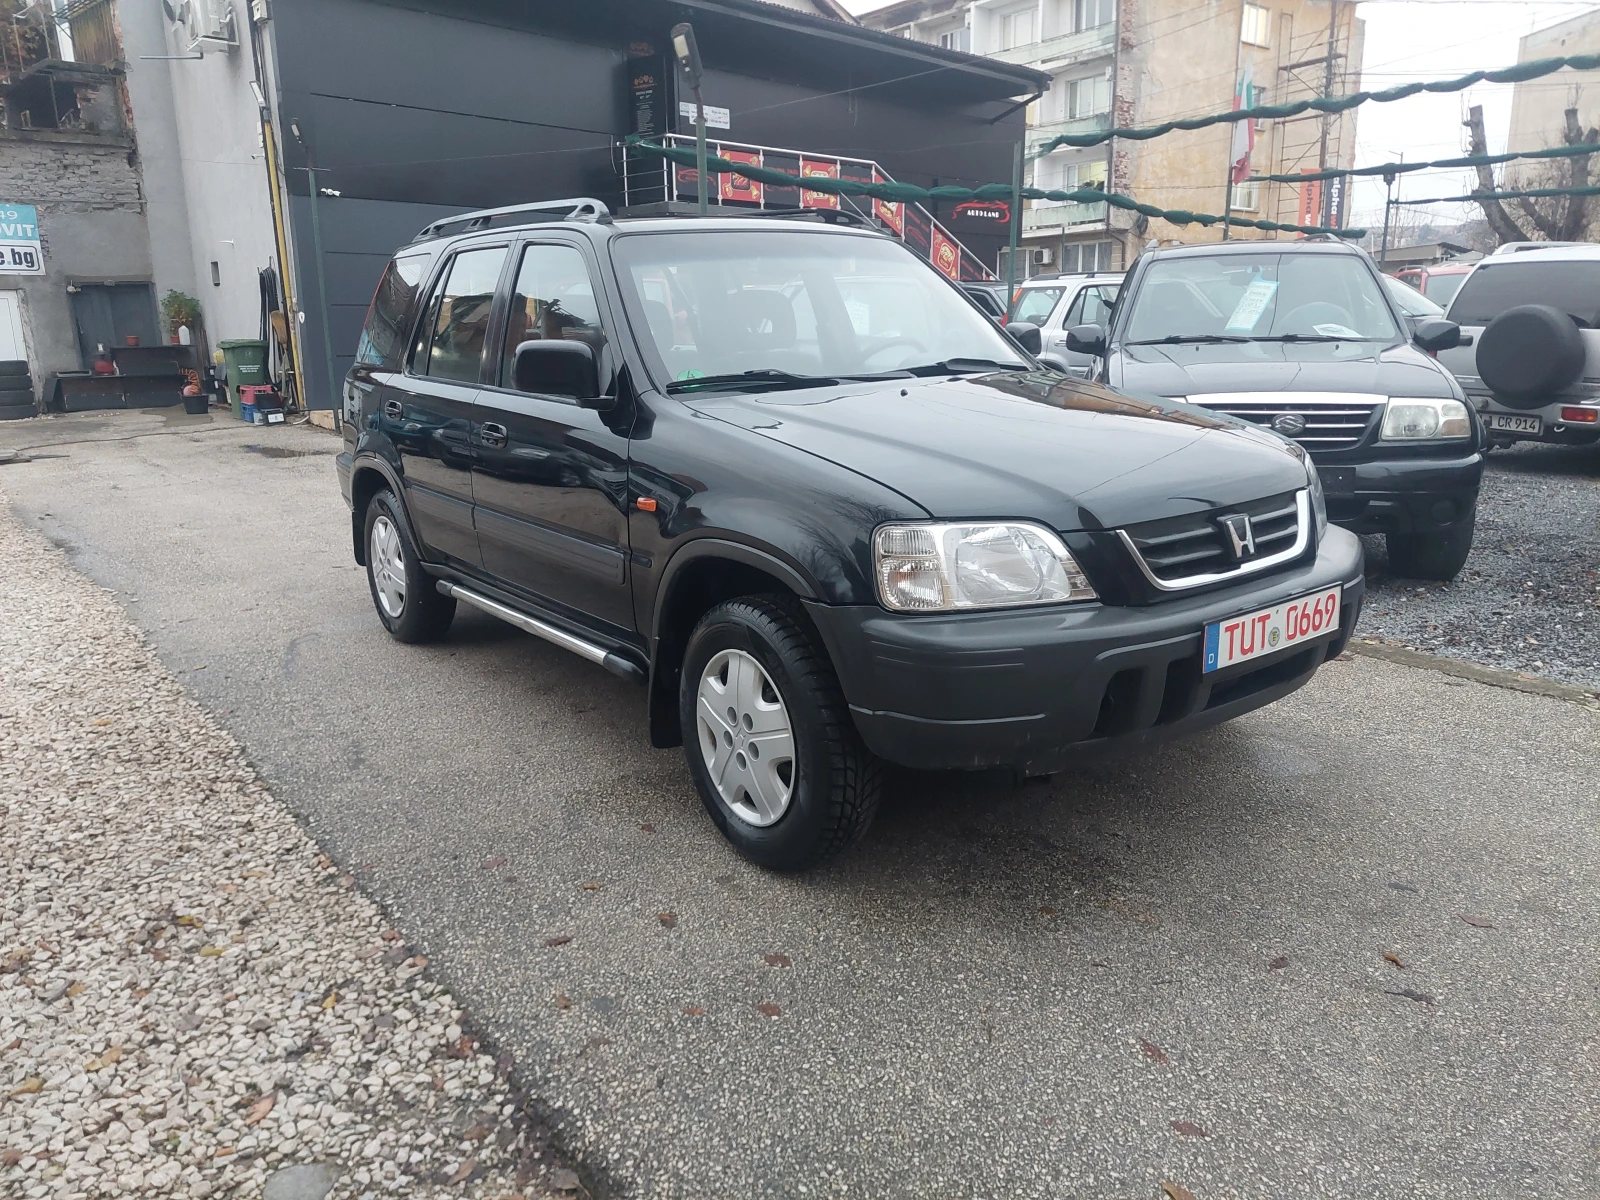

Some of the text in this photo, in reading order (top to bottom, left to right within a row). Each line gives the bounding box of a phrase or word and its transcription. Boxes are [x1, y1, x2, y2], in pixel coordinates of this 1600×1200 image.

[1498, 416, 1512, 428] CR
[1515, 418, 1536, 431] 914
[1225, 593, 1336, 661] TUT 0669
[1208, 653, 1215, 665] D
